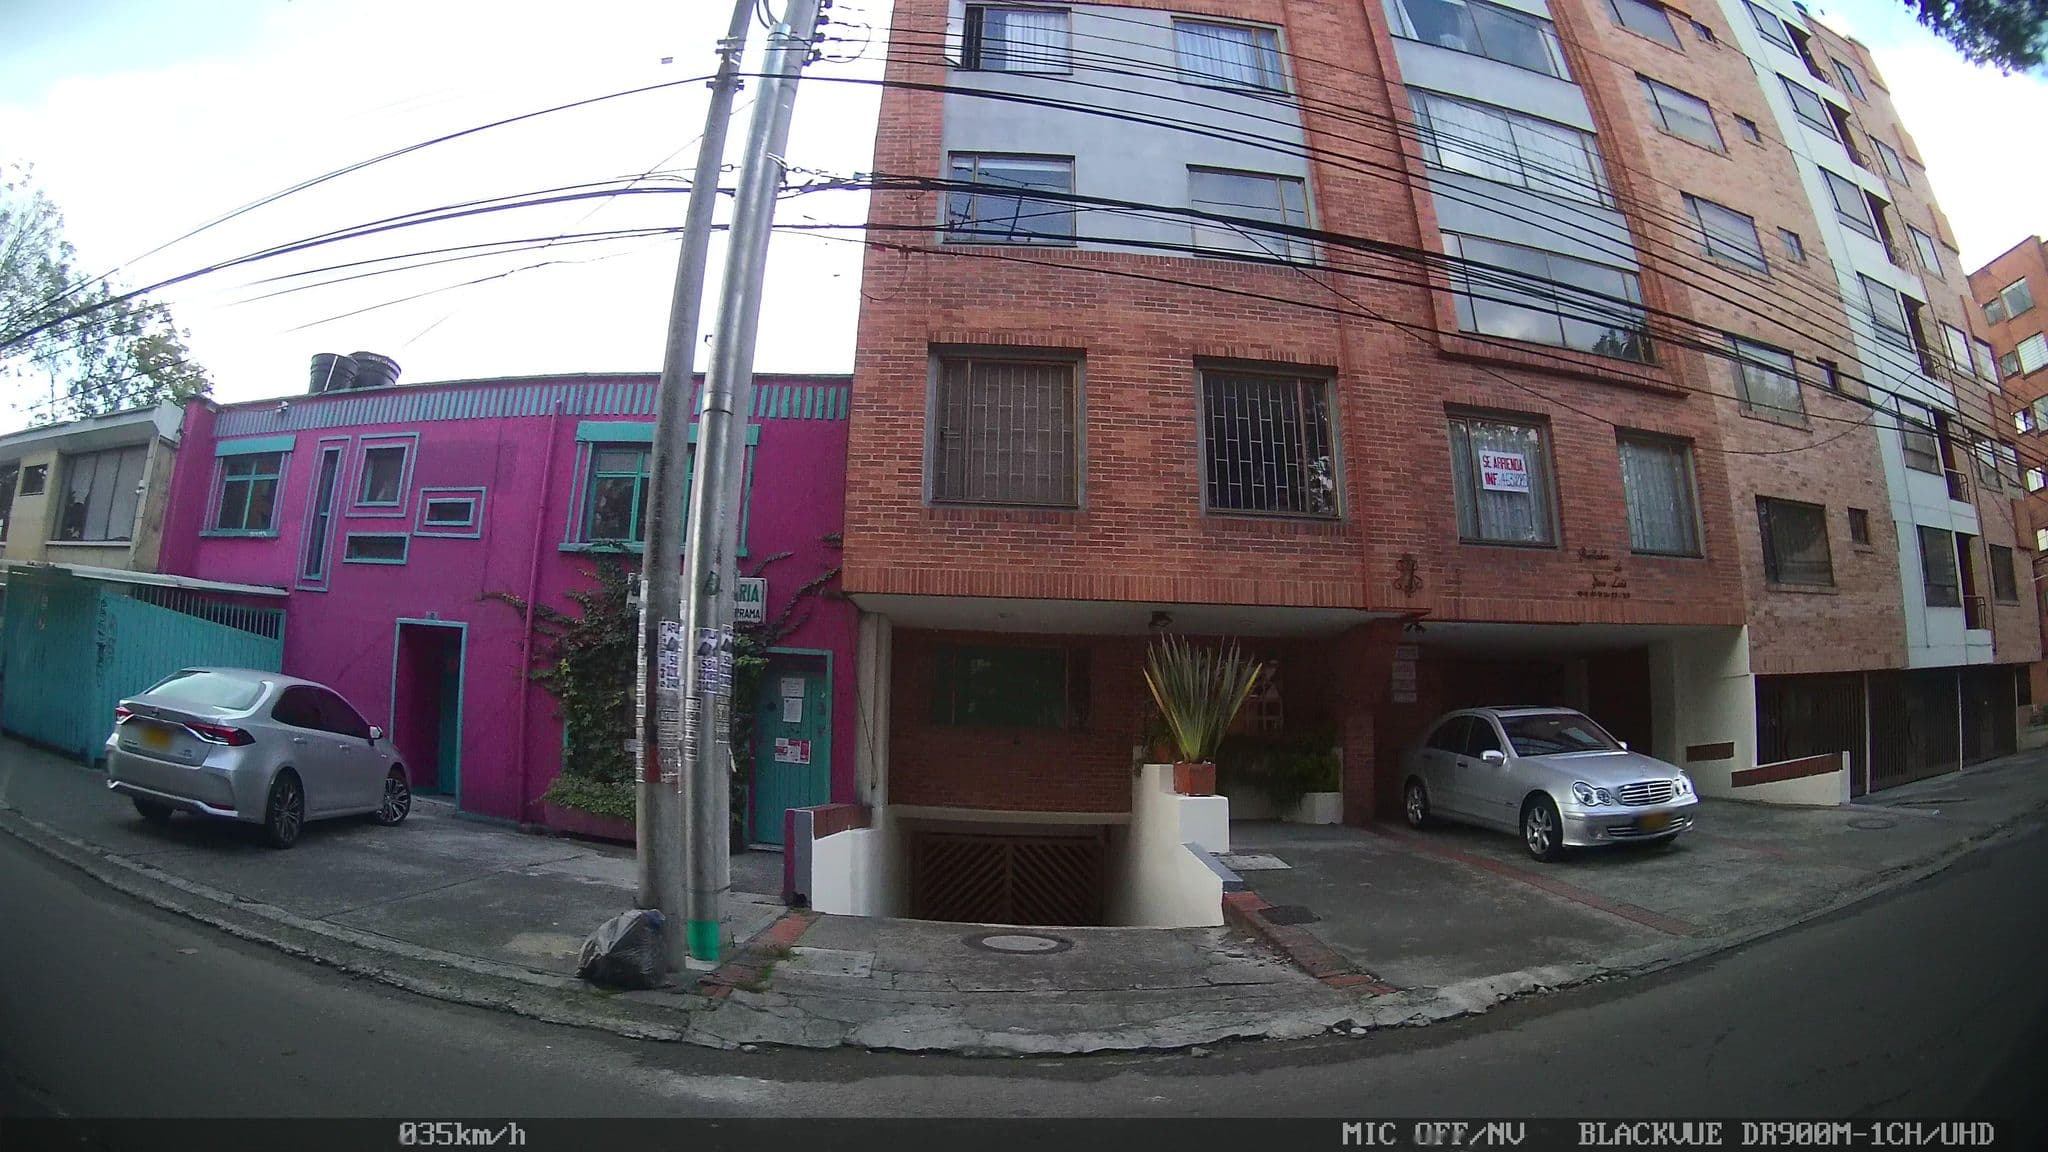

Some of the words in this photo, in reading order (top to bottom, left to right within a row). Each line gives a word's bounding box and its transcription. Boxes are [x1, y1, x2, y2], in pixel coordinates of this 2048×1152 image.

[1482, 454, 1492, 468] SE
[1493, 456, 1524, 472] ARRIENDA
[735, 583, 760, 602] RIA
